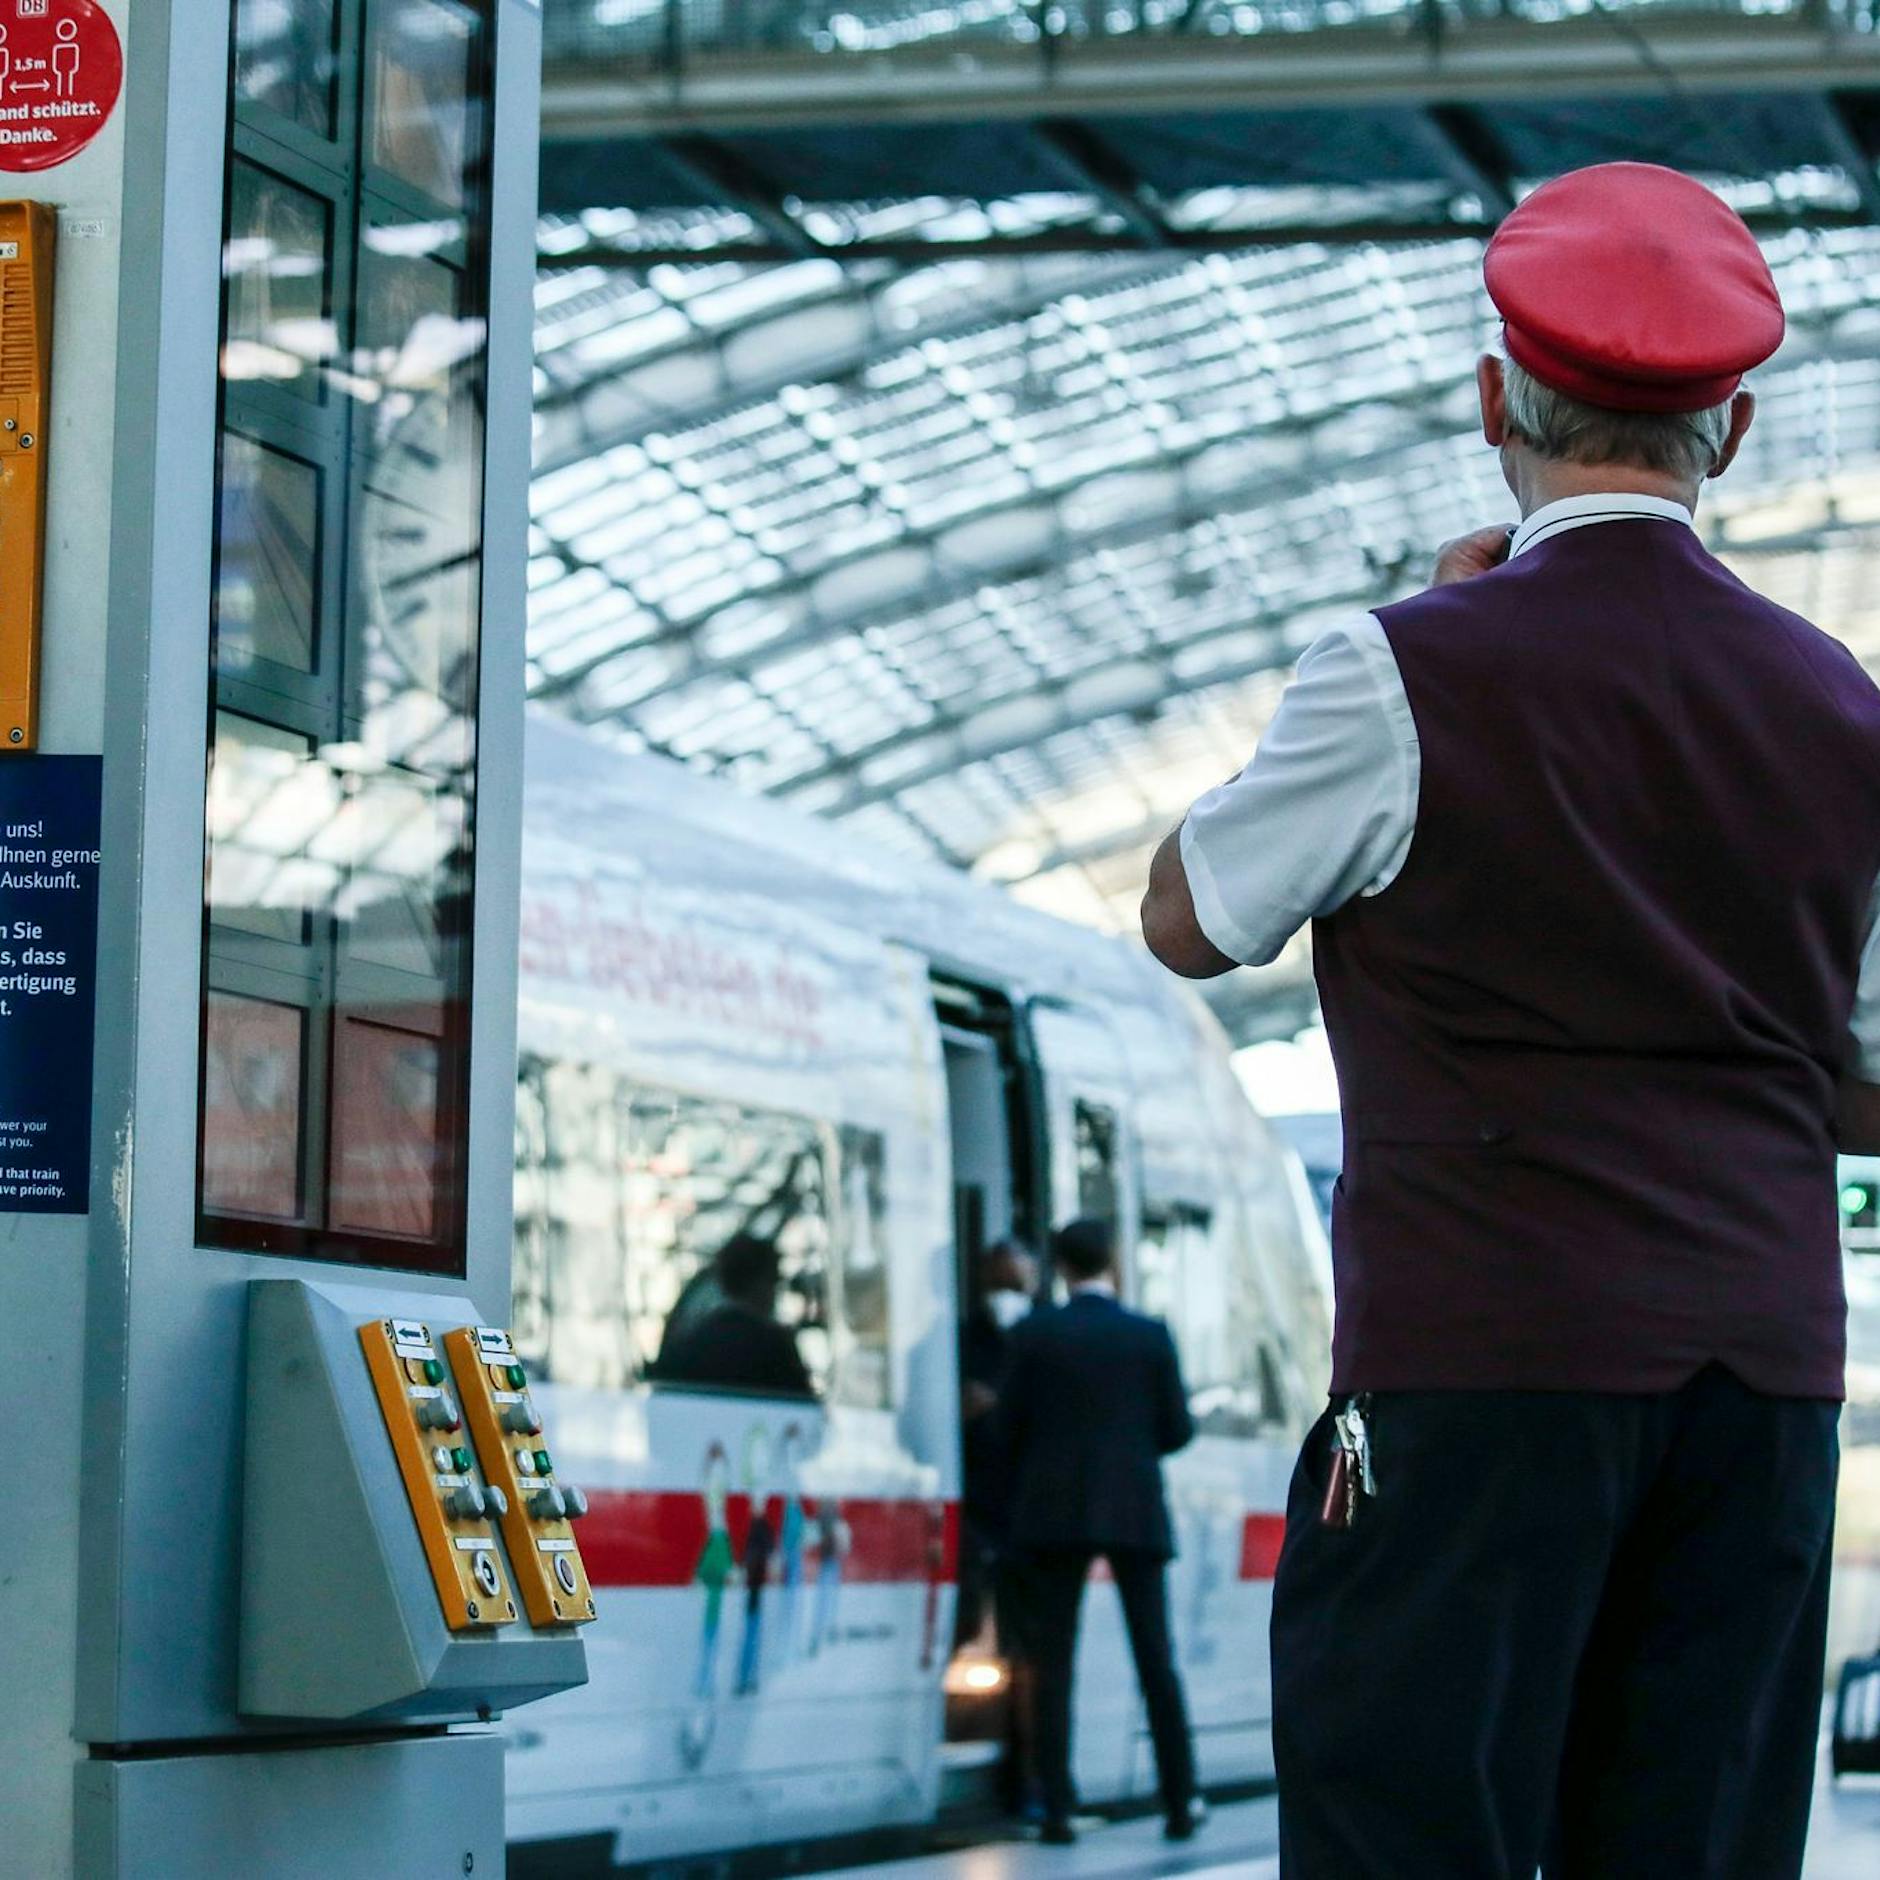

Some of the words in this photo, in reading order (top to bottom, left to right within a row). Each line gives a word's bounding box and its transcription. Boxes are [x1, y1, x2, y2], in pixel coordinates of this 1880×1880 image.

[21, 0, 43, 13] DB
[31, 100, 101, 118] schützt.
[0, 127, 58, 144] Danke.
[6, 820, 43, 838] uns!
[0, 845, 46, 863] Ihnen
[51, 849, 101, 868] gerne
[0, 871, 81, 889] Auskunft.
[13, 921, 43, 939] Sie
[0, 950, 17, 967] s,
[22, 947, 66, 965] dass
[0, 972, 76, 995] ertigung
[0, 999, 12, 1016] t.
[22, 1122, 48, 1134] your
[9, 1137, 33, 1149] you.
[6, 1167, 30, 1179] that
[32, 1167, 60, 1180] train
[20, 1183, 66, 1199] priority.
